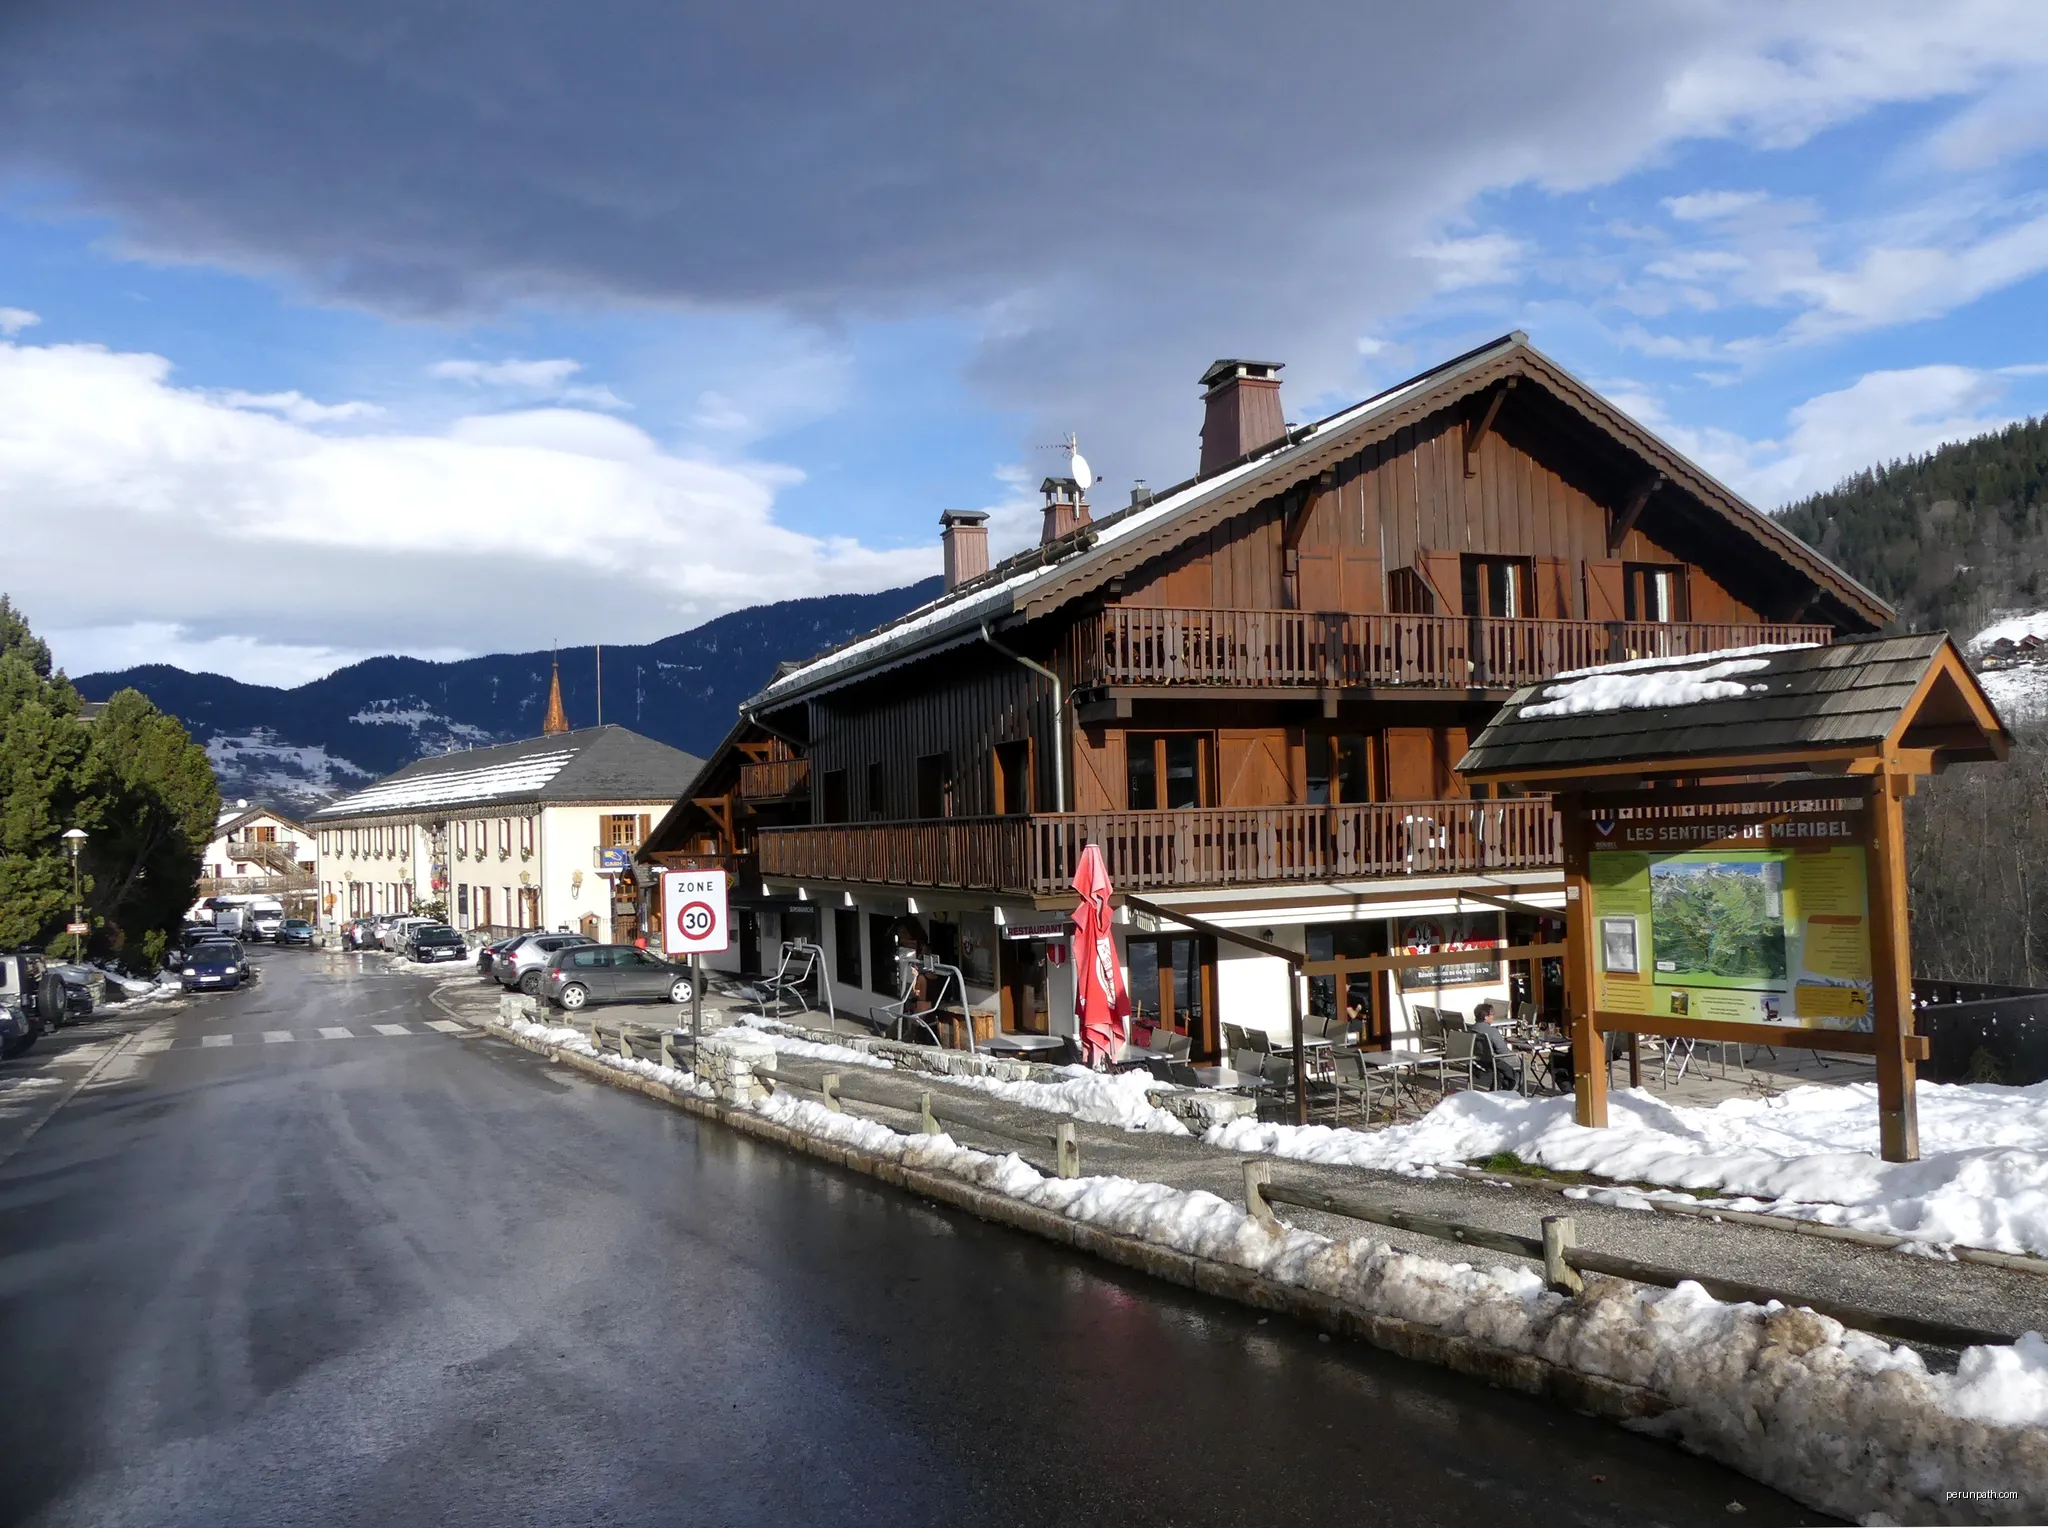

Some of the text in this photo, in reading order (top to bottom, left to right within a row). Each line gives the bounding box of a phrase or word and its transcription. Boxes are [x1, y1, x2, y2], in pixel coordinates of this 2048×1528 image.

[1626, 818, 1852, 841] LES SENTIERS DE MÉRIBEL
[678, 881, 714, 893] ZONE
[685, 912, 708, 929] 30
[1008, 924, 1062, 936] RESTAURANT
